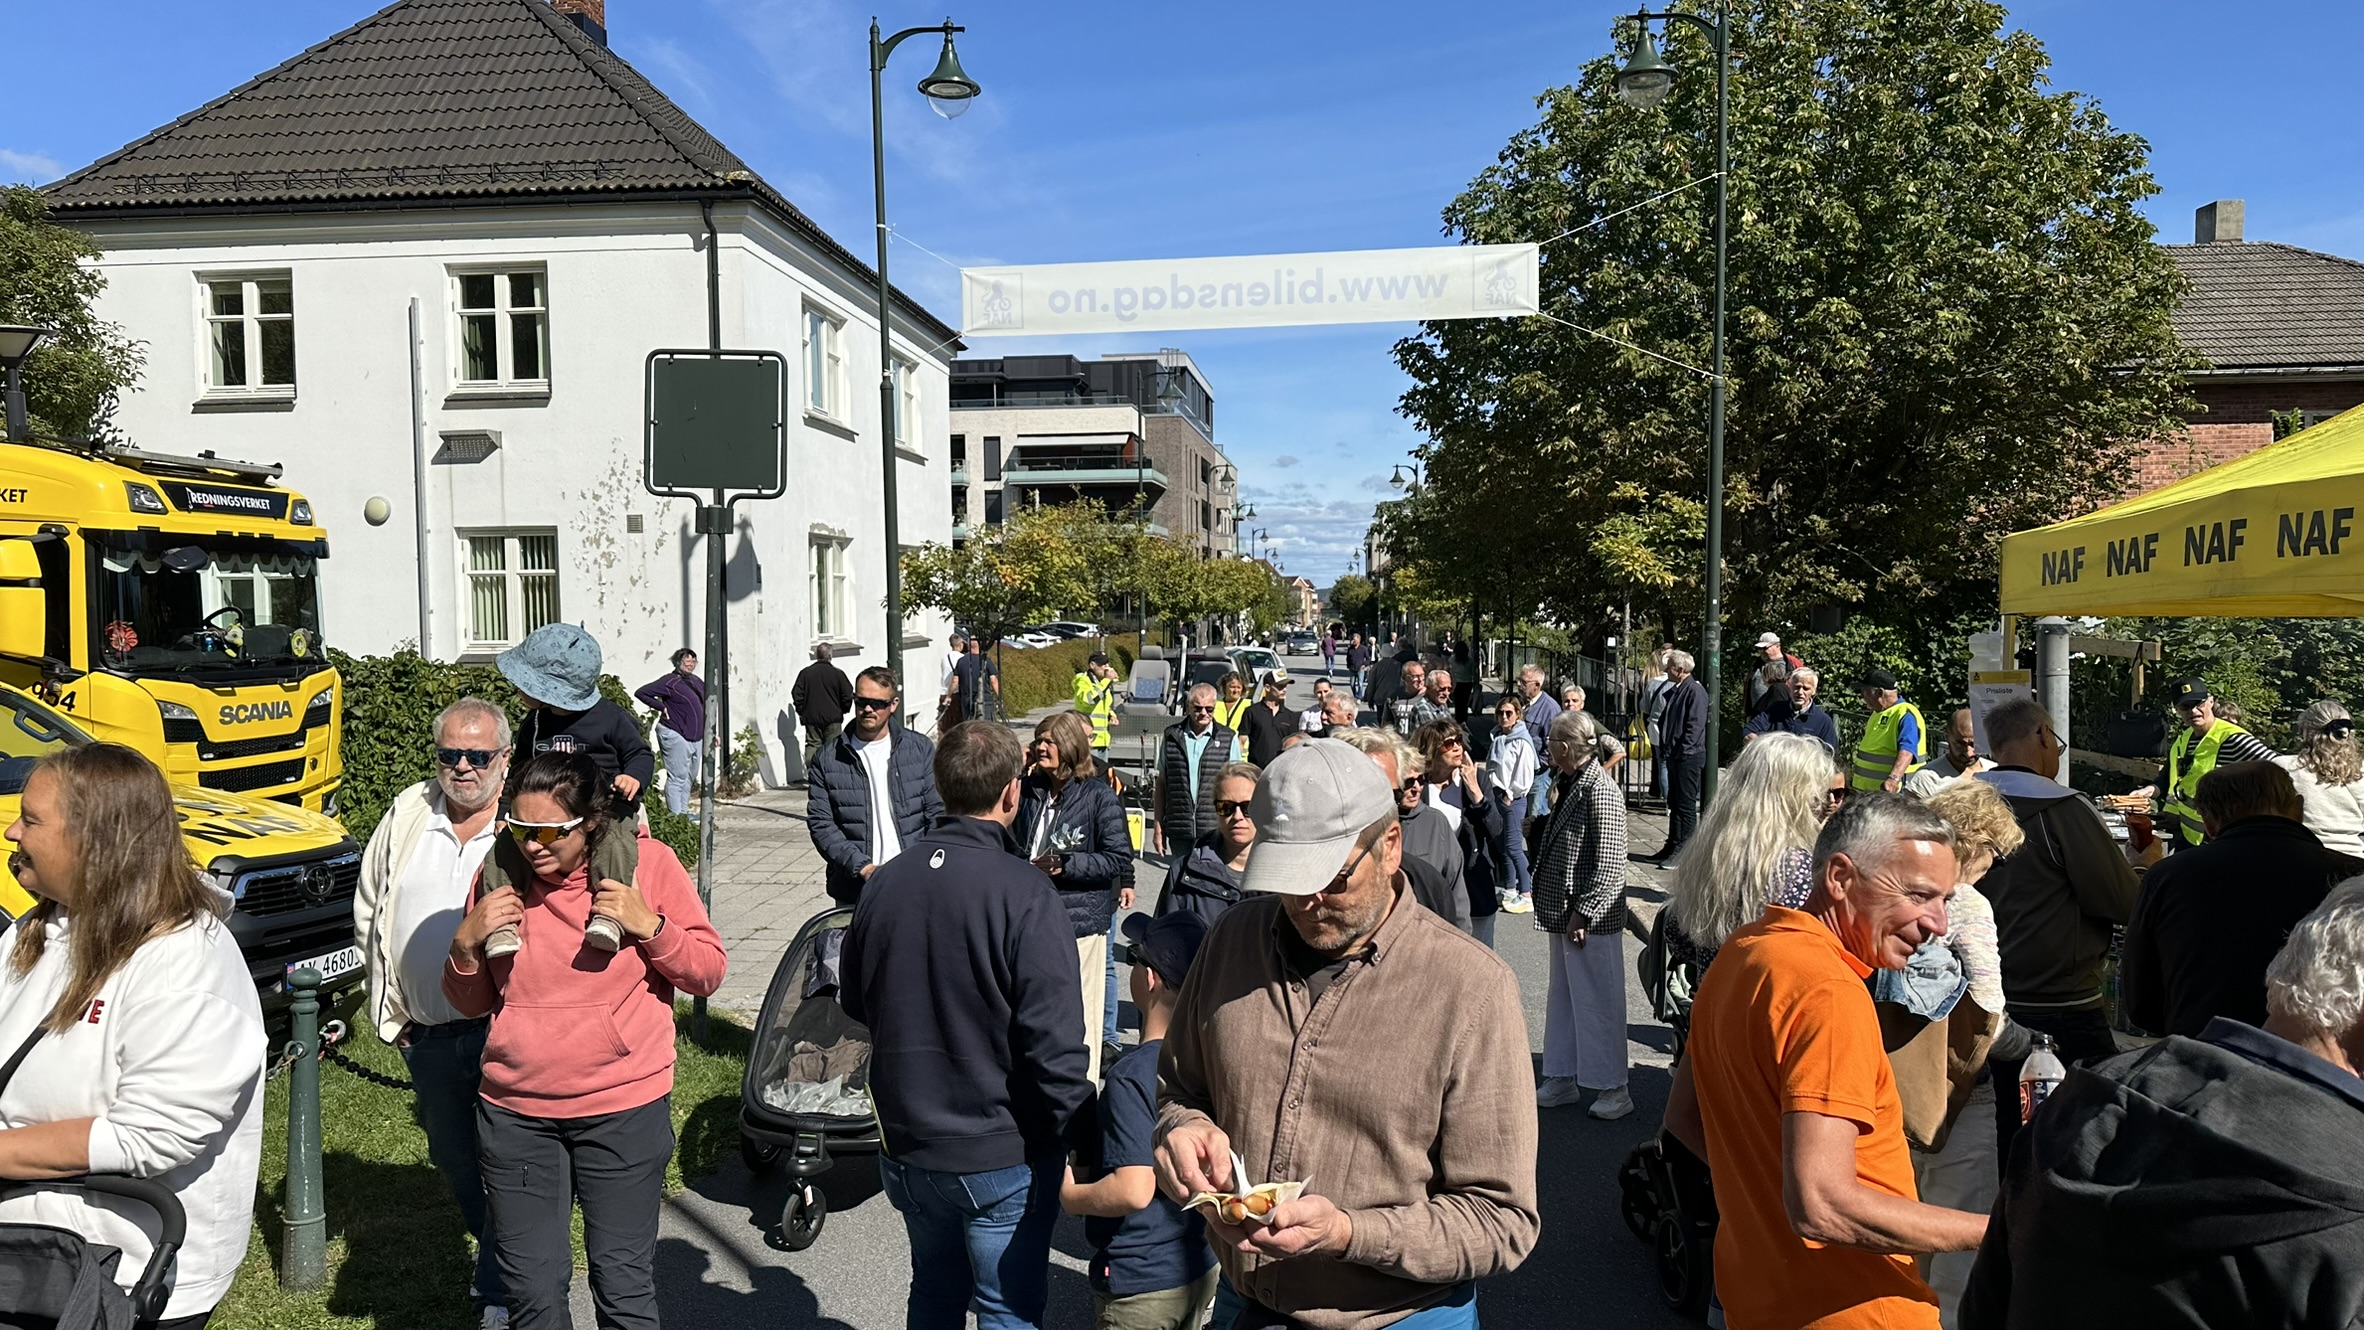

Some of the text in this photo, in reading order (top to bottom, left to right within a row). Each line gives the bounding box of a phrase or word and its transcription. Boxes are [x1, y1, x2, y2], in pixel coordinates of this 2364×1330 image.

[190, 491, 271, 510] REDNINGSVERKET
[2042, 507, 2354, 586] NAF NAF NAF NAF
[1986, 687, 2013, 695] Prisliste
[219, 700, 293, 725] SCANIA
[182, 815, 306, 846] NAF
[322, 948, 360, 975] 4680
